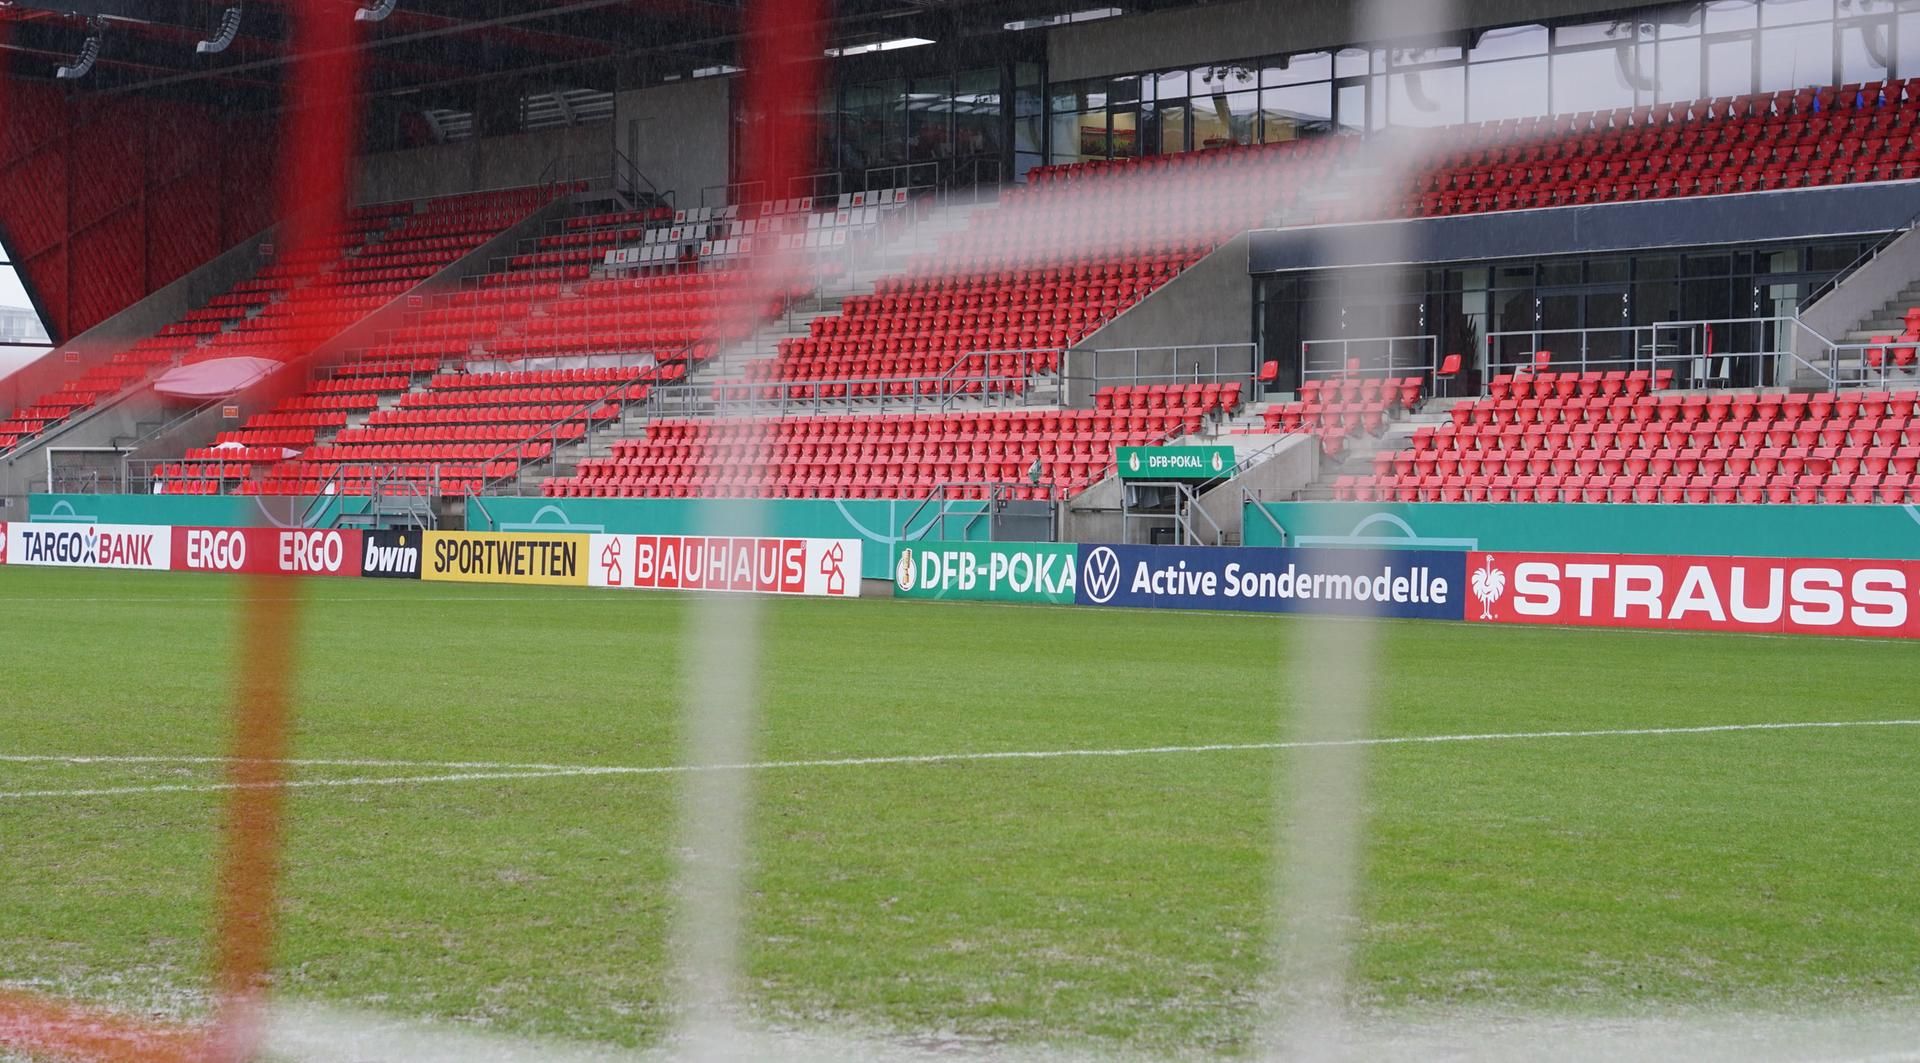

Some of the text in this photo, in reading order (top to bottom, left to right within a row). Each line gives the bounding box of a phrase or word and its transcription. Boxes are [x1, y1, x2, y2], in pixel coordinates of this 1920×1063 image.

[1149, 455, 1203, 468] DFB-POKAL
[186, 530, 246, 570] ERGO
[279, 531, 343, 572] ERGO
[364, 536, 418, 573] bwin
[434, 539, 576, 576] SPORTWETTEN
[638, 543, 803, 585] BAUHAUS
[1131, 561, 1448, 604] Active Sondermodelle
[1513, 562, 1907, 628] STRAUSS
